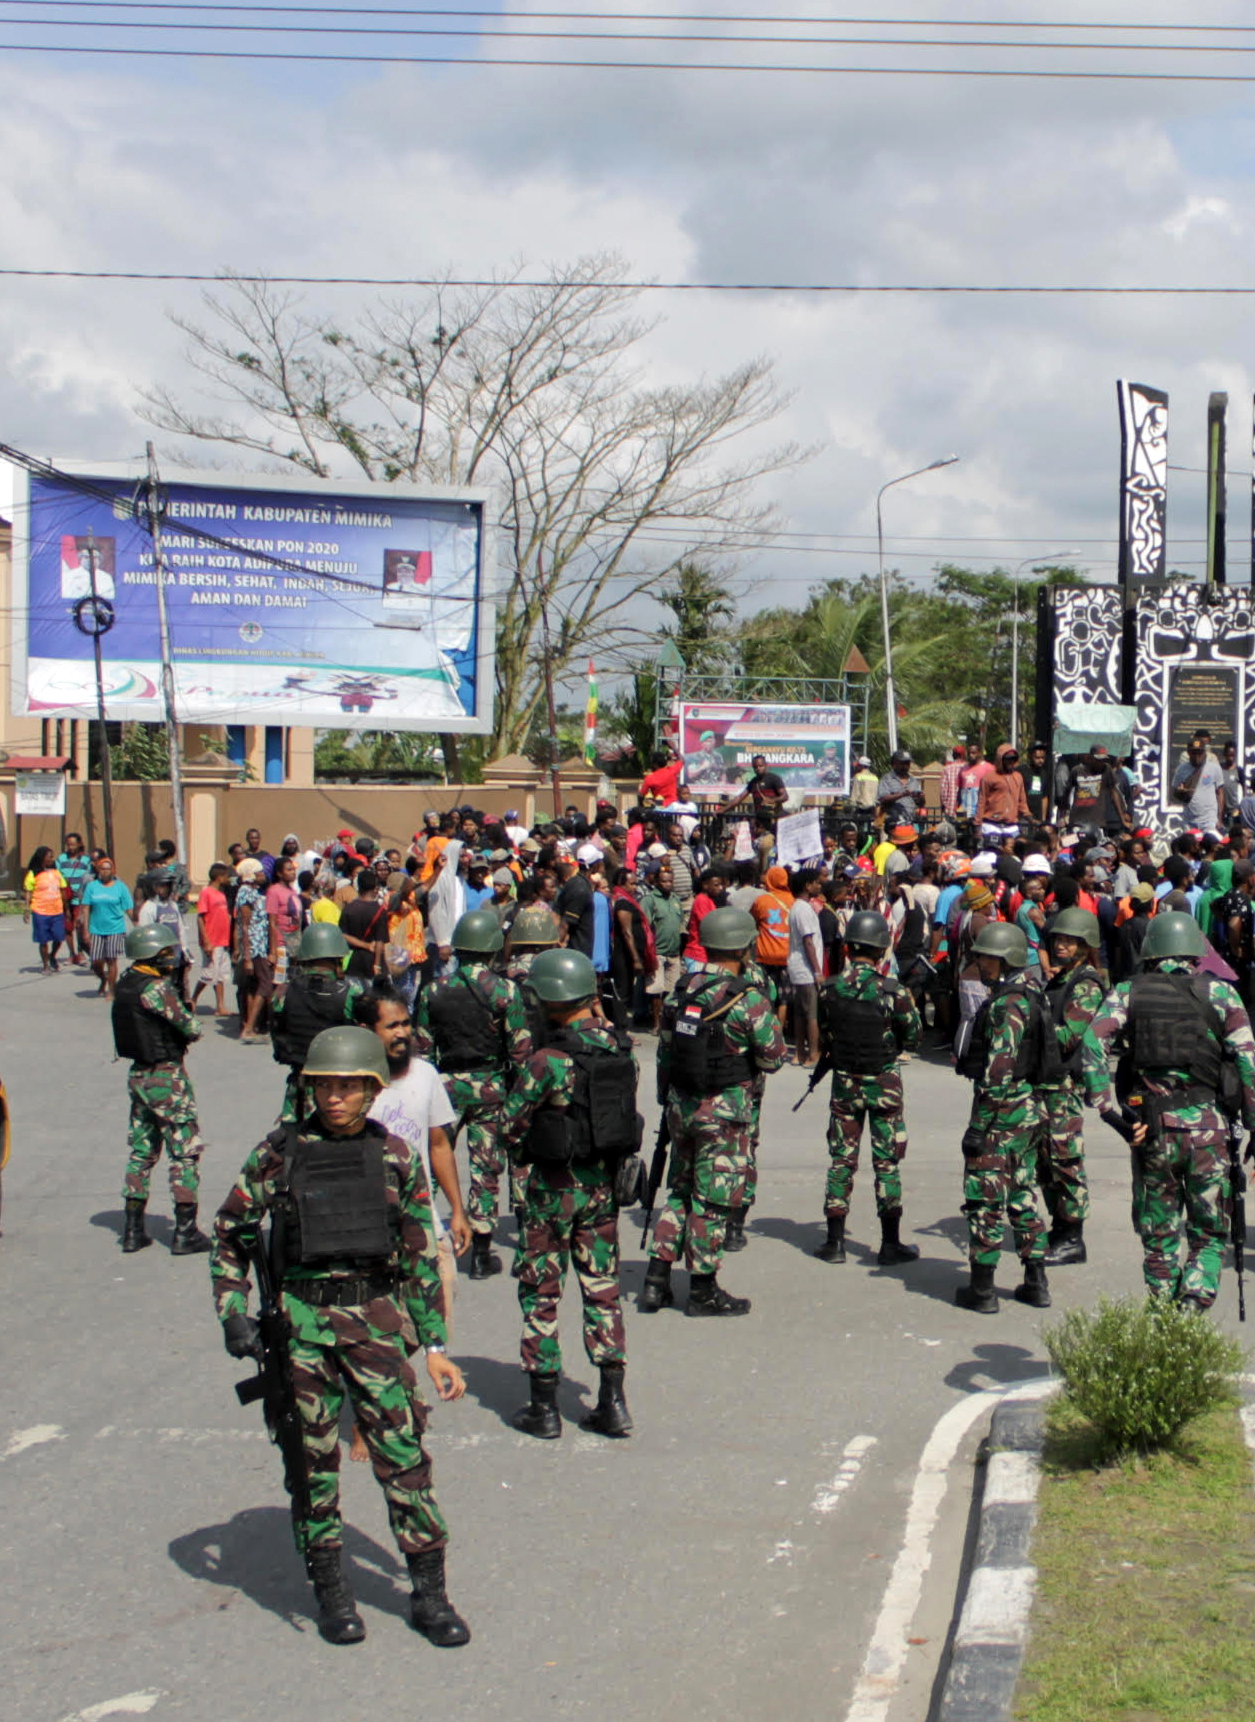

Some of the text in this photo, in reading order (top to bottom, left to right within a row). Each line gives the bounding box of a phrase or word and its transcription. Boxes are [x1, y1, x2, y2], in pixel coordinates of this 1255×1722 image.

[137, 501, 392, 528] PMERINTAH KABUPATEN MIMIKA
[160, 535, 195, 549] MARI
[277, 540, 304, 553] PON
[307, 542, 339, 554] 2020
[140, 554, 169, 566] KIA
[172, 555, 204, 567] RAIH
[207, 555, 240, 569] KOTA
[306, 560, 358, 574] MENUJU
[179, 573, 230, 588] BERSIH,
[234, 575, 277, 590] SEHAT,
[284, 578, 328, 592] INDAH,
[191, 592, 307, 608] AMAN DAN DAMAI
[737, 753, 815, 764] BHANGKARA
